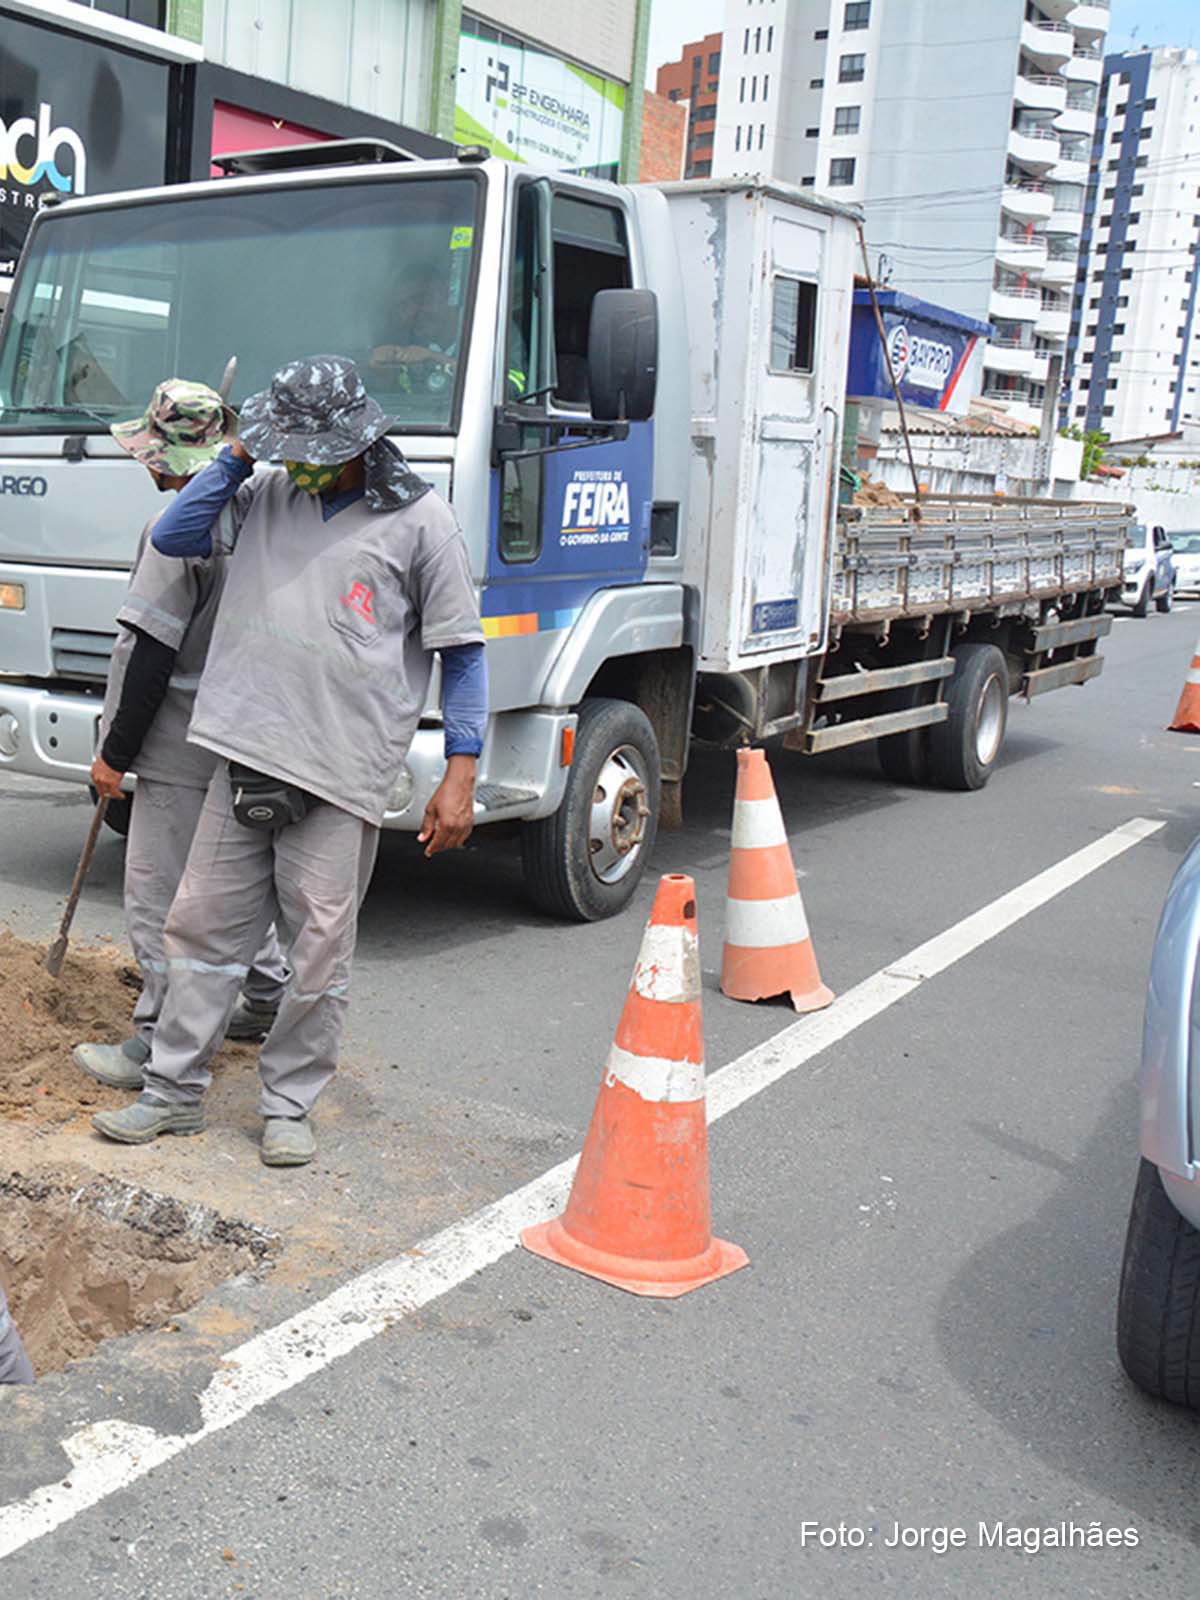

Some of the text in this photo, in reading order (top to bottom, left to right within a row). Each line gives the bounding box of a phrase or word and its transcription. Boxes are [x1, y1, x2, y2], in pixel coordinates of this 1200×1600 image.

[907, 335, 954, 377] BAYPRO
[573, 470, 623, 481] PREFEITURA DE
[561, 482, 631, 527] FEIRA
